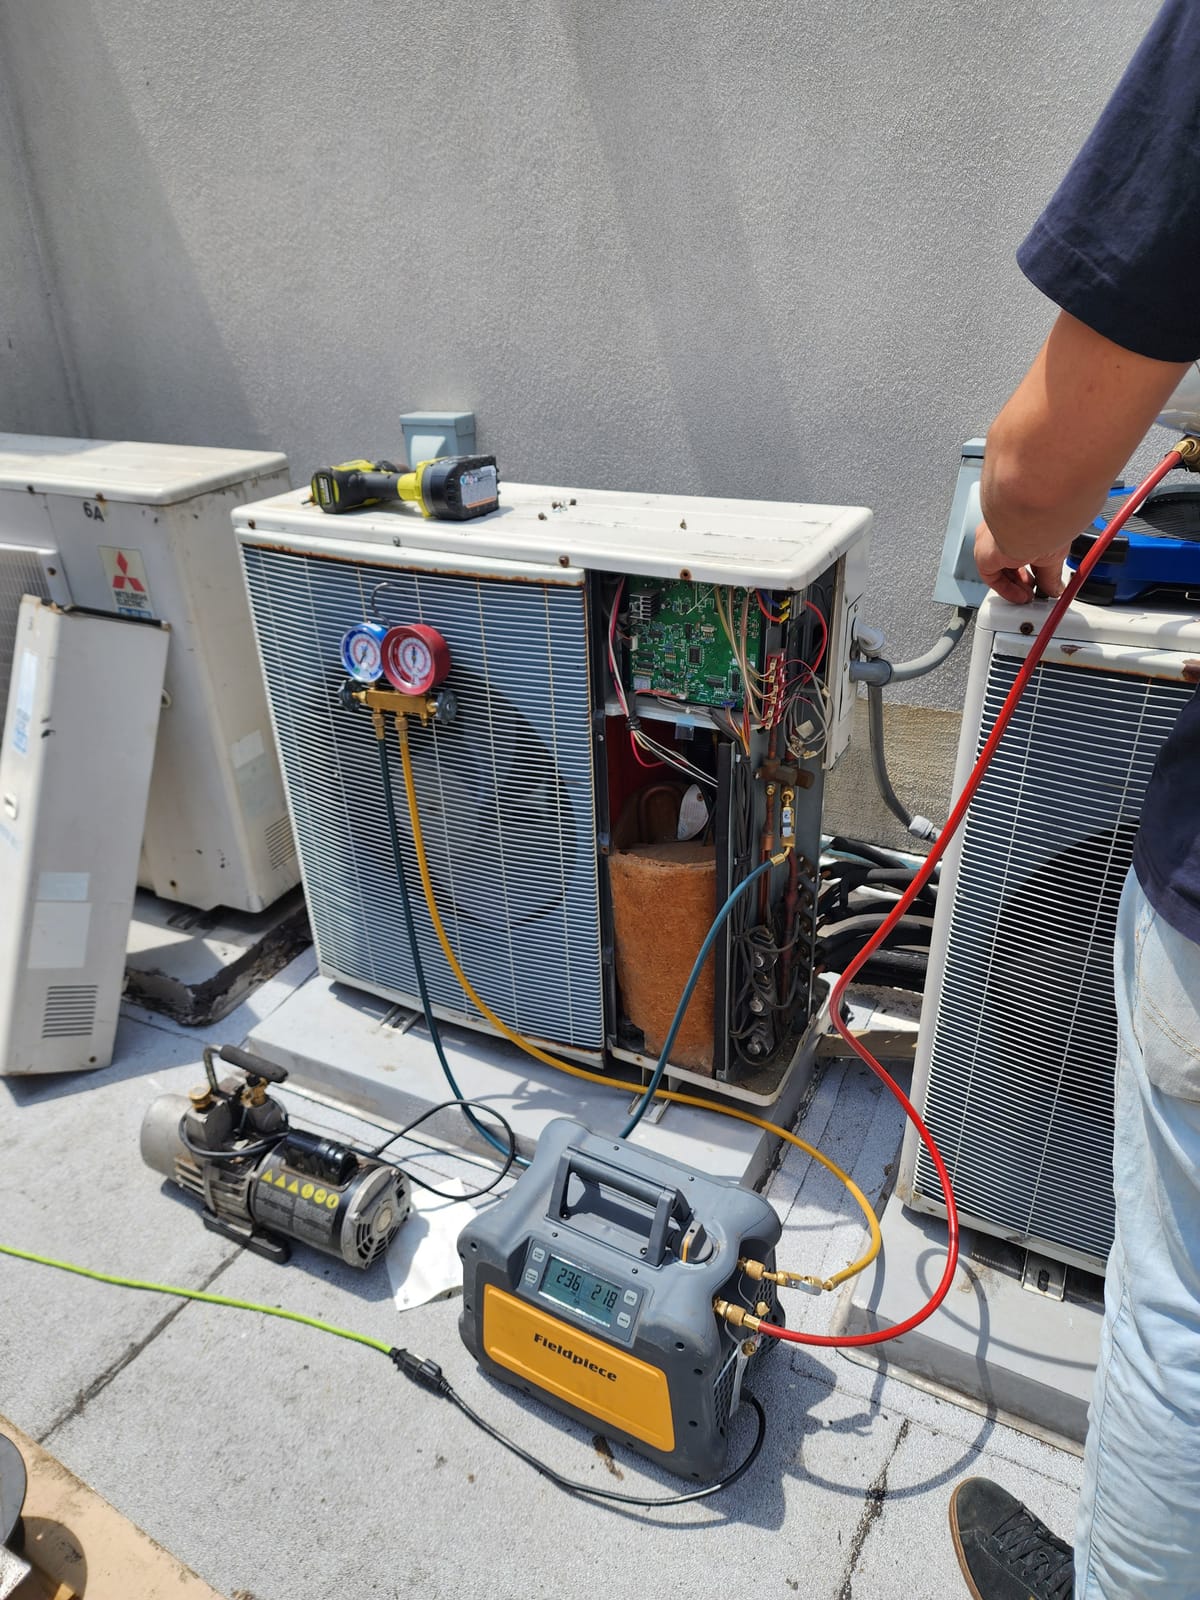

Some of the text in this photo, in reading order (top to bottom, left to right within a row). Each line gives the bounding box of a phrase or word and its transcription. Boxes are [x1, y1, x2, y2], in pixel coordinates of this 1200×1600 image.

[83, 501, 105, 522] 6A
[556, 1267, 582, 1293] 236
[590, 1284, 618, 1310] 218
[534, 1333, 617, 1382] Fieldpiece
